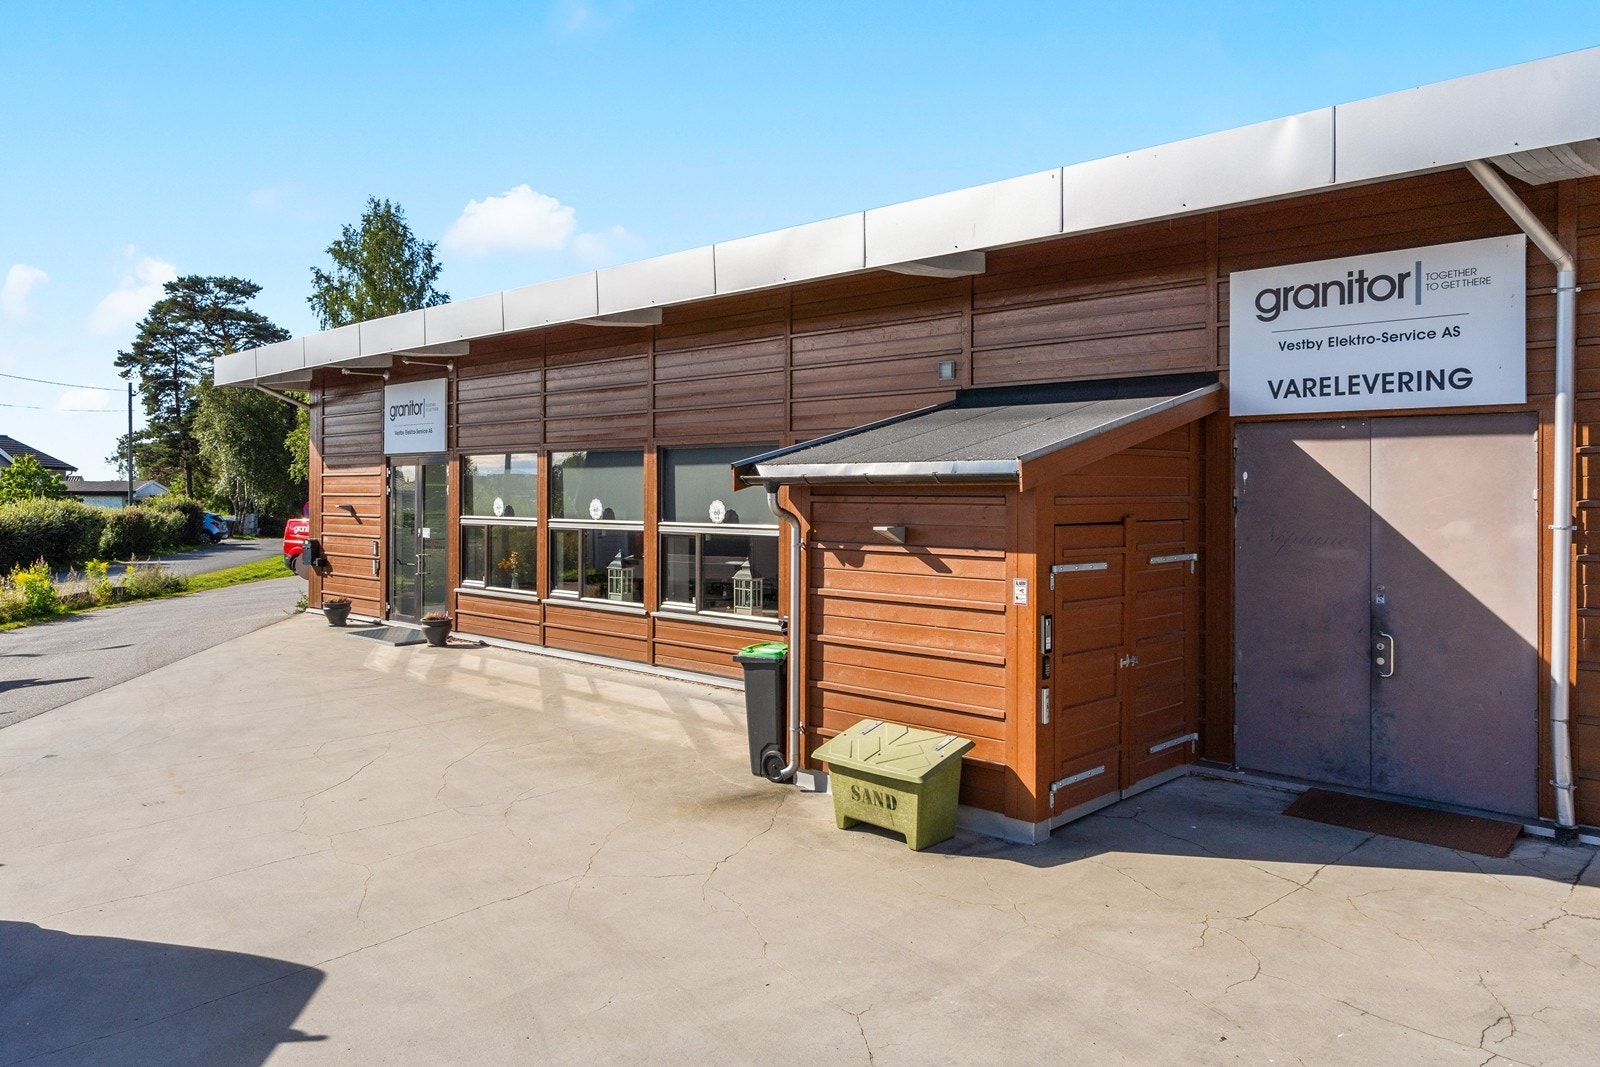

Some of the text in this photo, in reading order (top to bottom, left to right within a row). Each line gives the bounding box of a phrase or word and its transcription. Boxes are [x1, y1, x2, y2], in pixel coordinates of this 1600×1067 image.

[1426, 267, 1477, 281] TOGETHER
[1426, 276, 1491, 291] TO GET THERE
[1255, 269, 1411, 322] granitor
[1278, 325, 1461, 351] Vestby Elektro-Service AS
[1267, 367, 1474, 400] VARELEVERING
[390, 400, 423, 421] granitor
[851, 784, 898, 811] SAND
